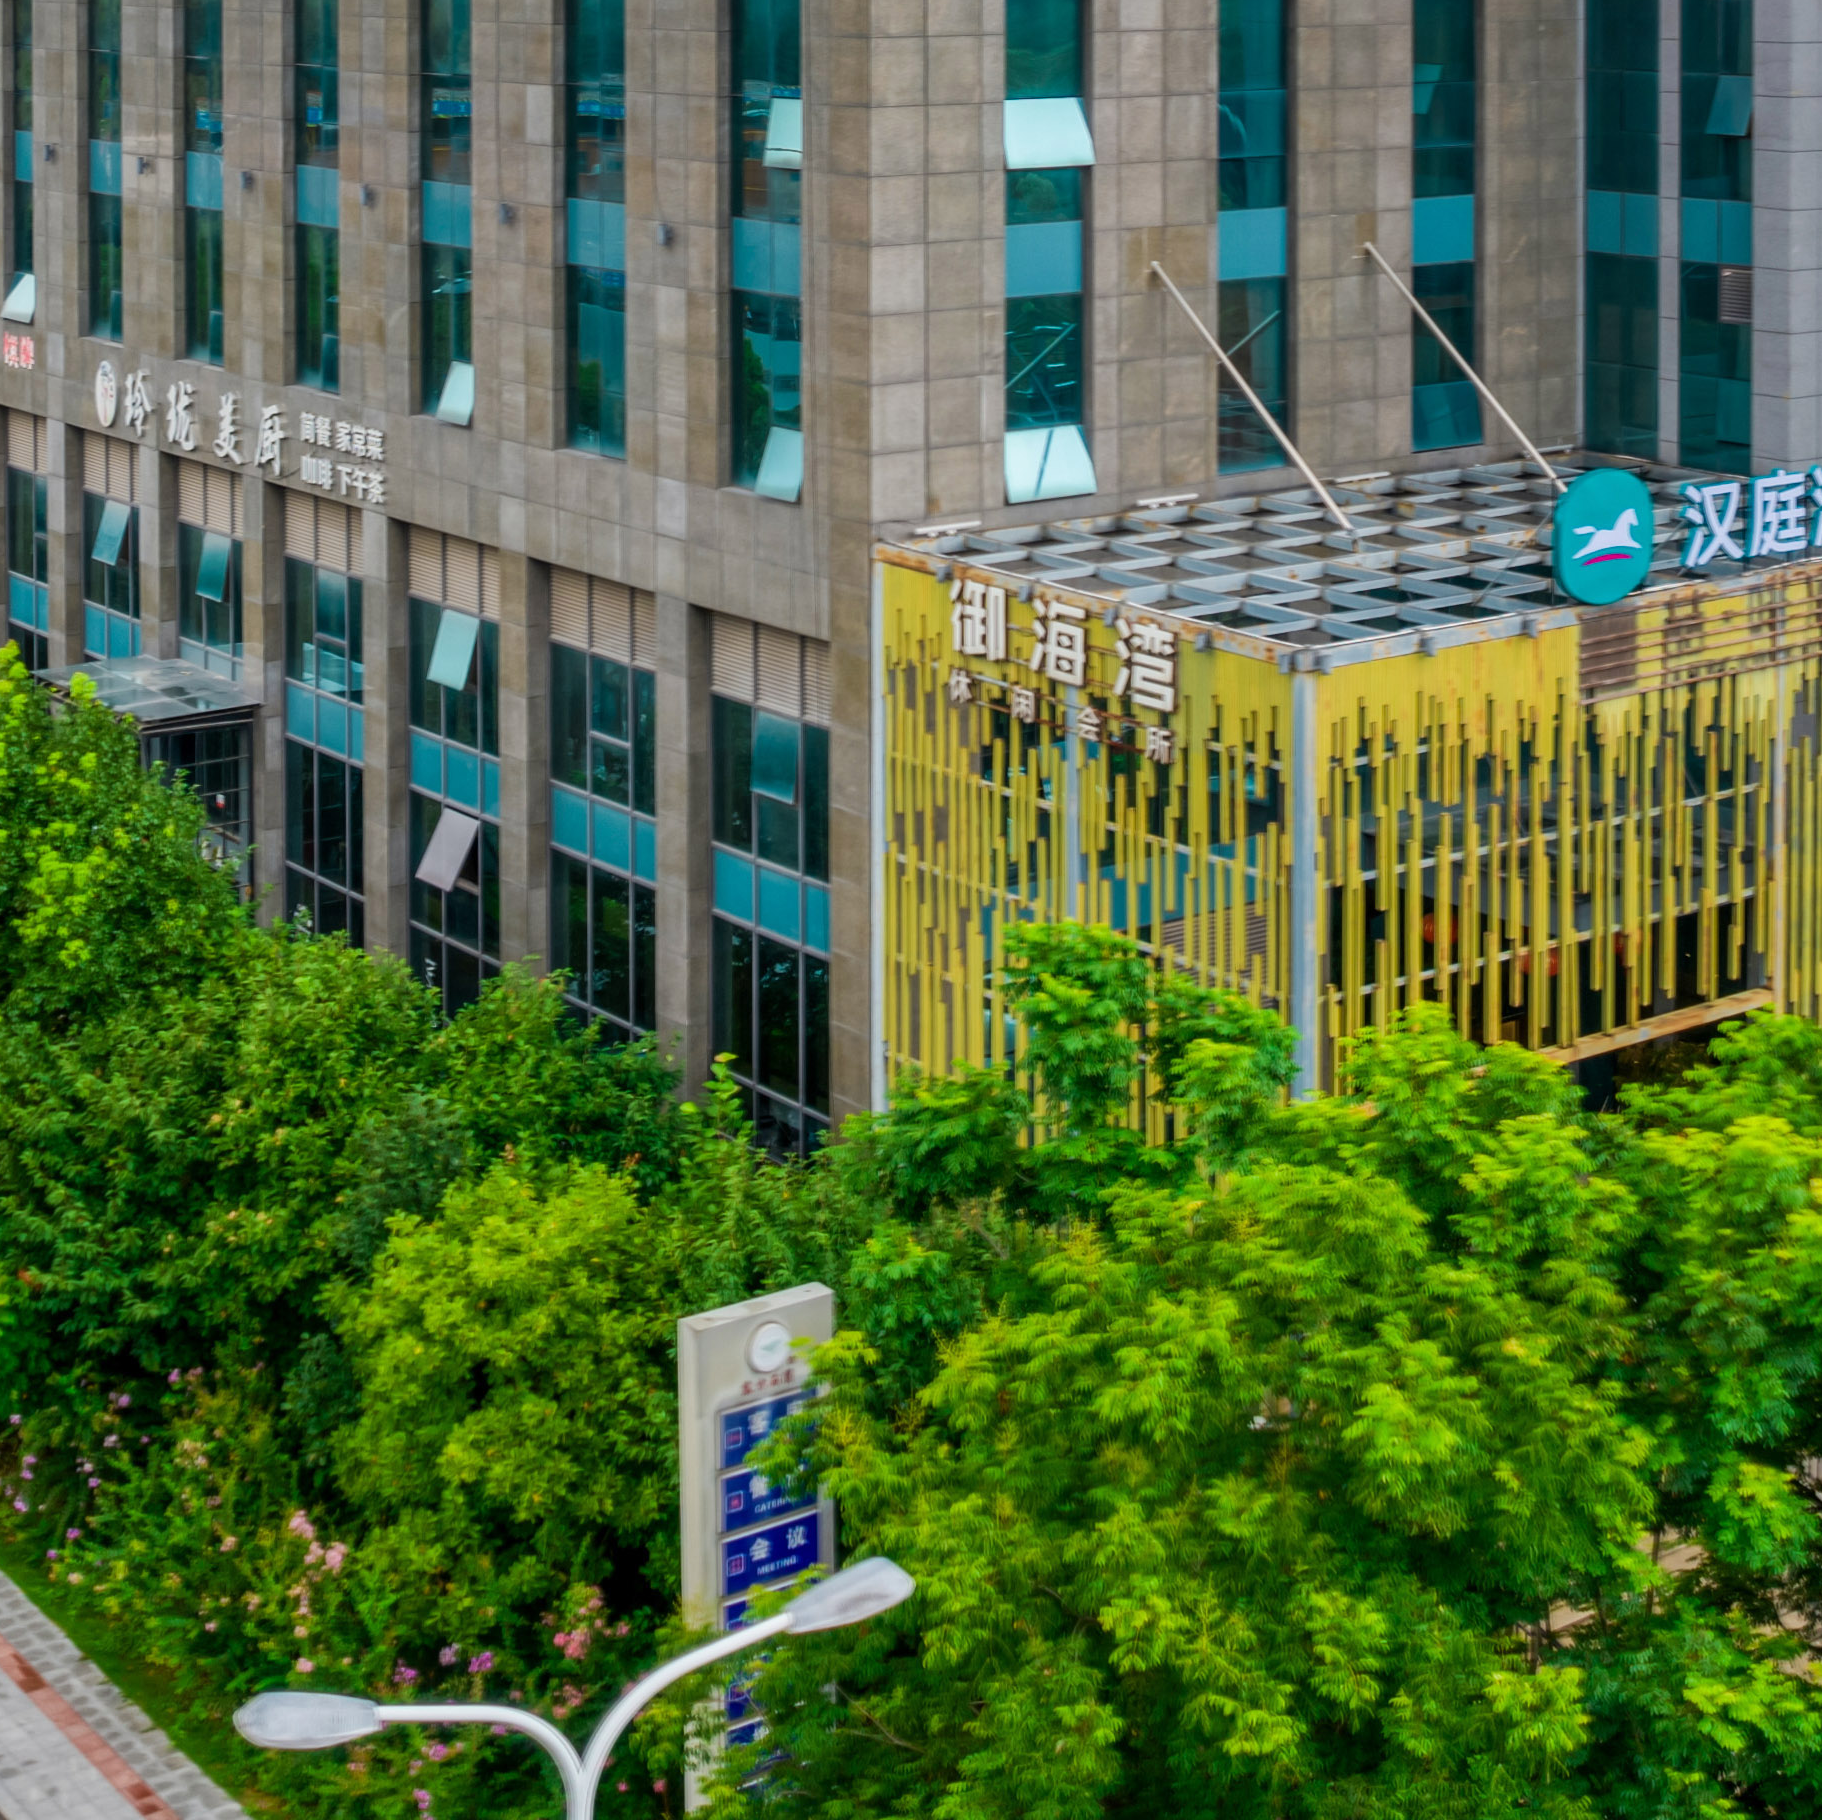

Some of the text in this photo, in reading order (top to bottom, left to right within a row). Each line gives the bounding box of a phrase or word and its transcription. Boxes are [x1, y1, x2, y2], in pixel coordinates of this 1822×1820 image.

[300, 453, 385, 504] 咖啡 下午茶
[335, 421, 385, 461] 家常菜
[950, 578, 1177, 715] 御海湾
[947, 667, 1175, 766] 休闲会所
